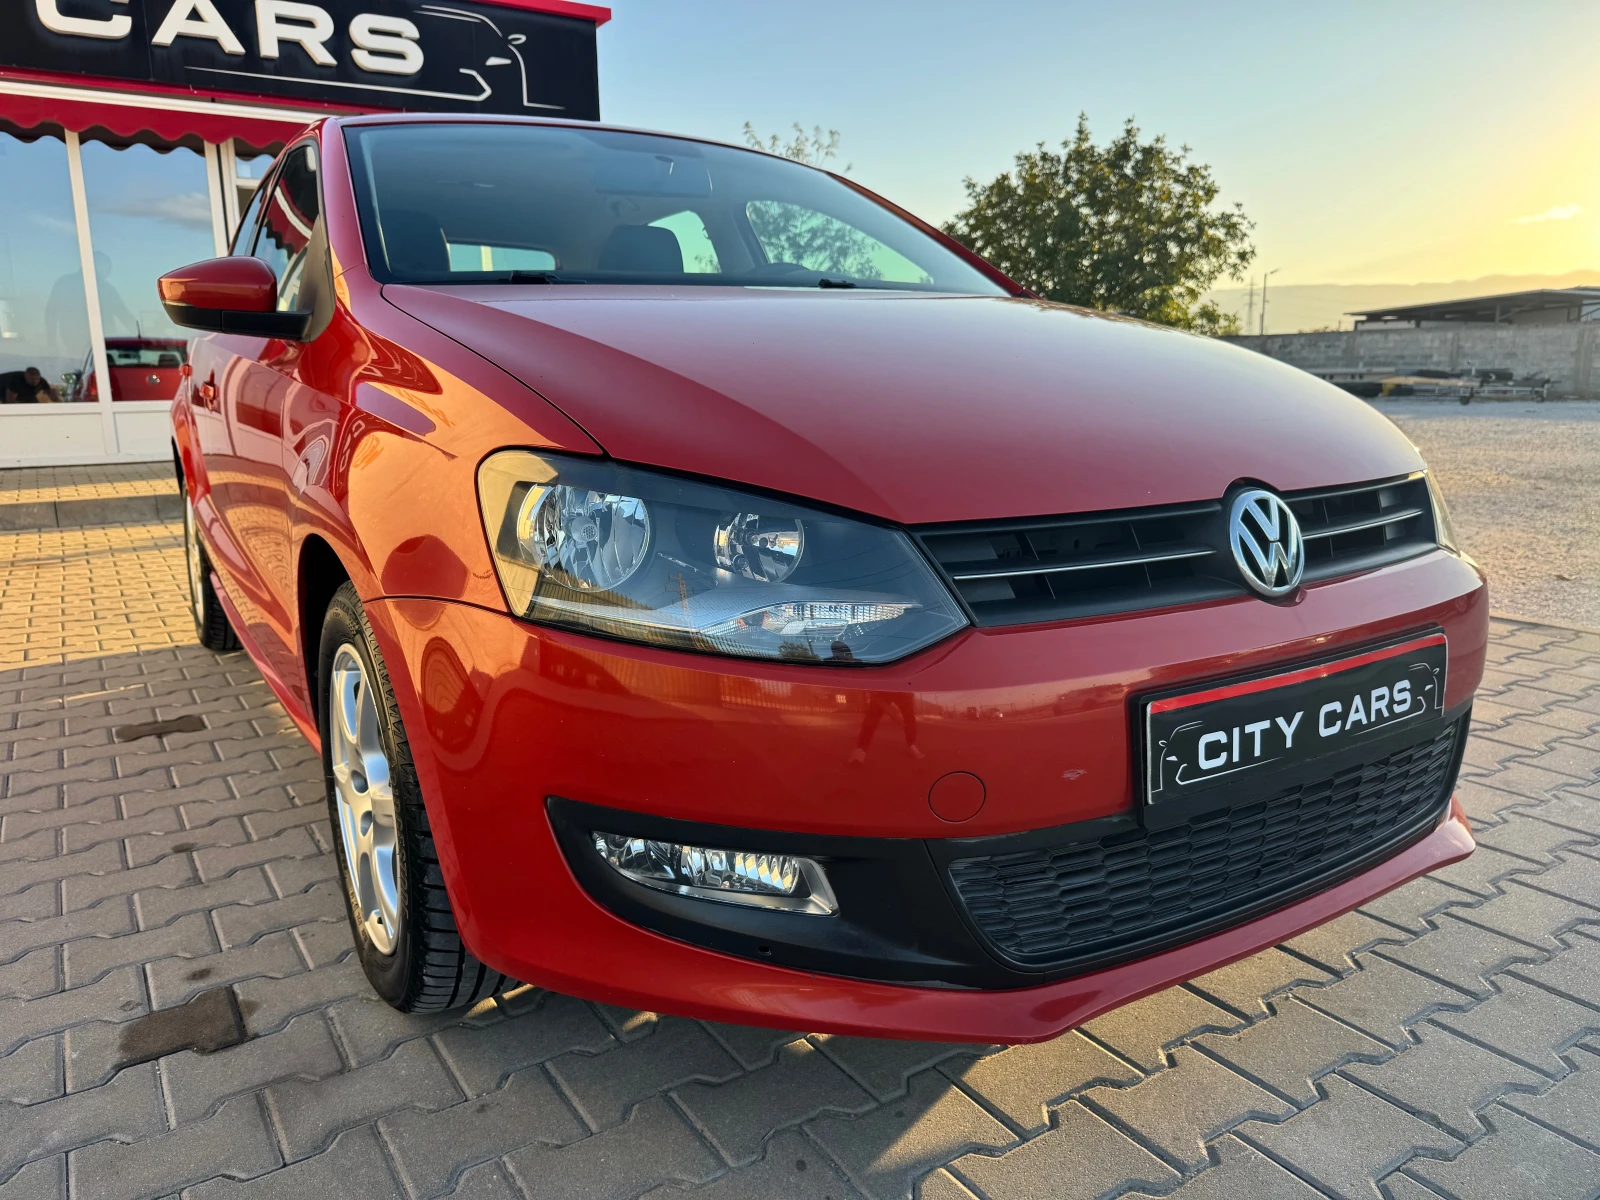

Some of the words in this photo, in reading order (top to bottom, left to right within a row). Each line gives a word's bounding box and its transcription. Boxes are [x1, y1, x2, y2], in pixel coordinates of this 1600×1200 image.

[36, 0, 424, 75] CARS
[1198, 711, 1304, 770] CITY
[1318, 679, 1411, 738] CARS
